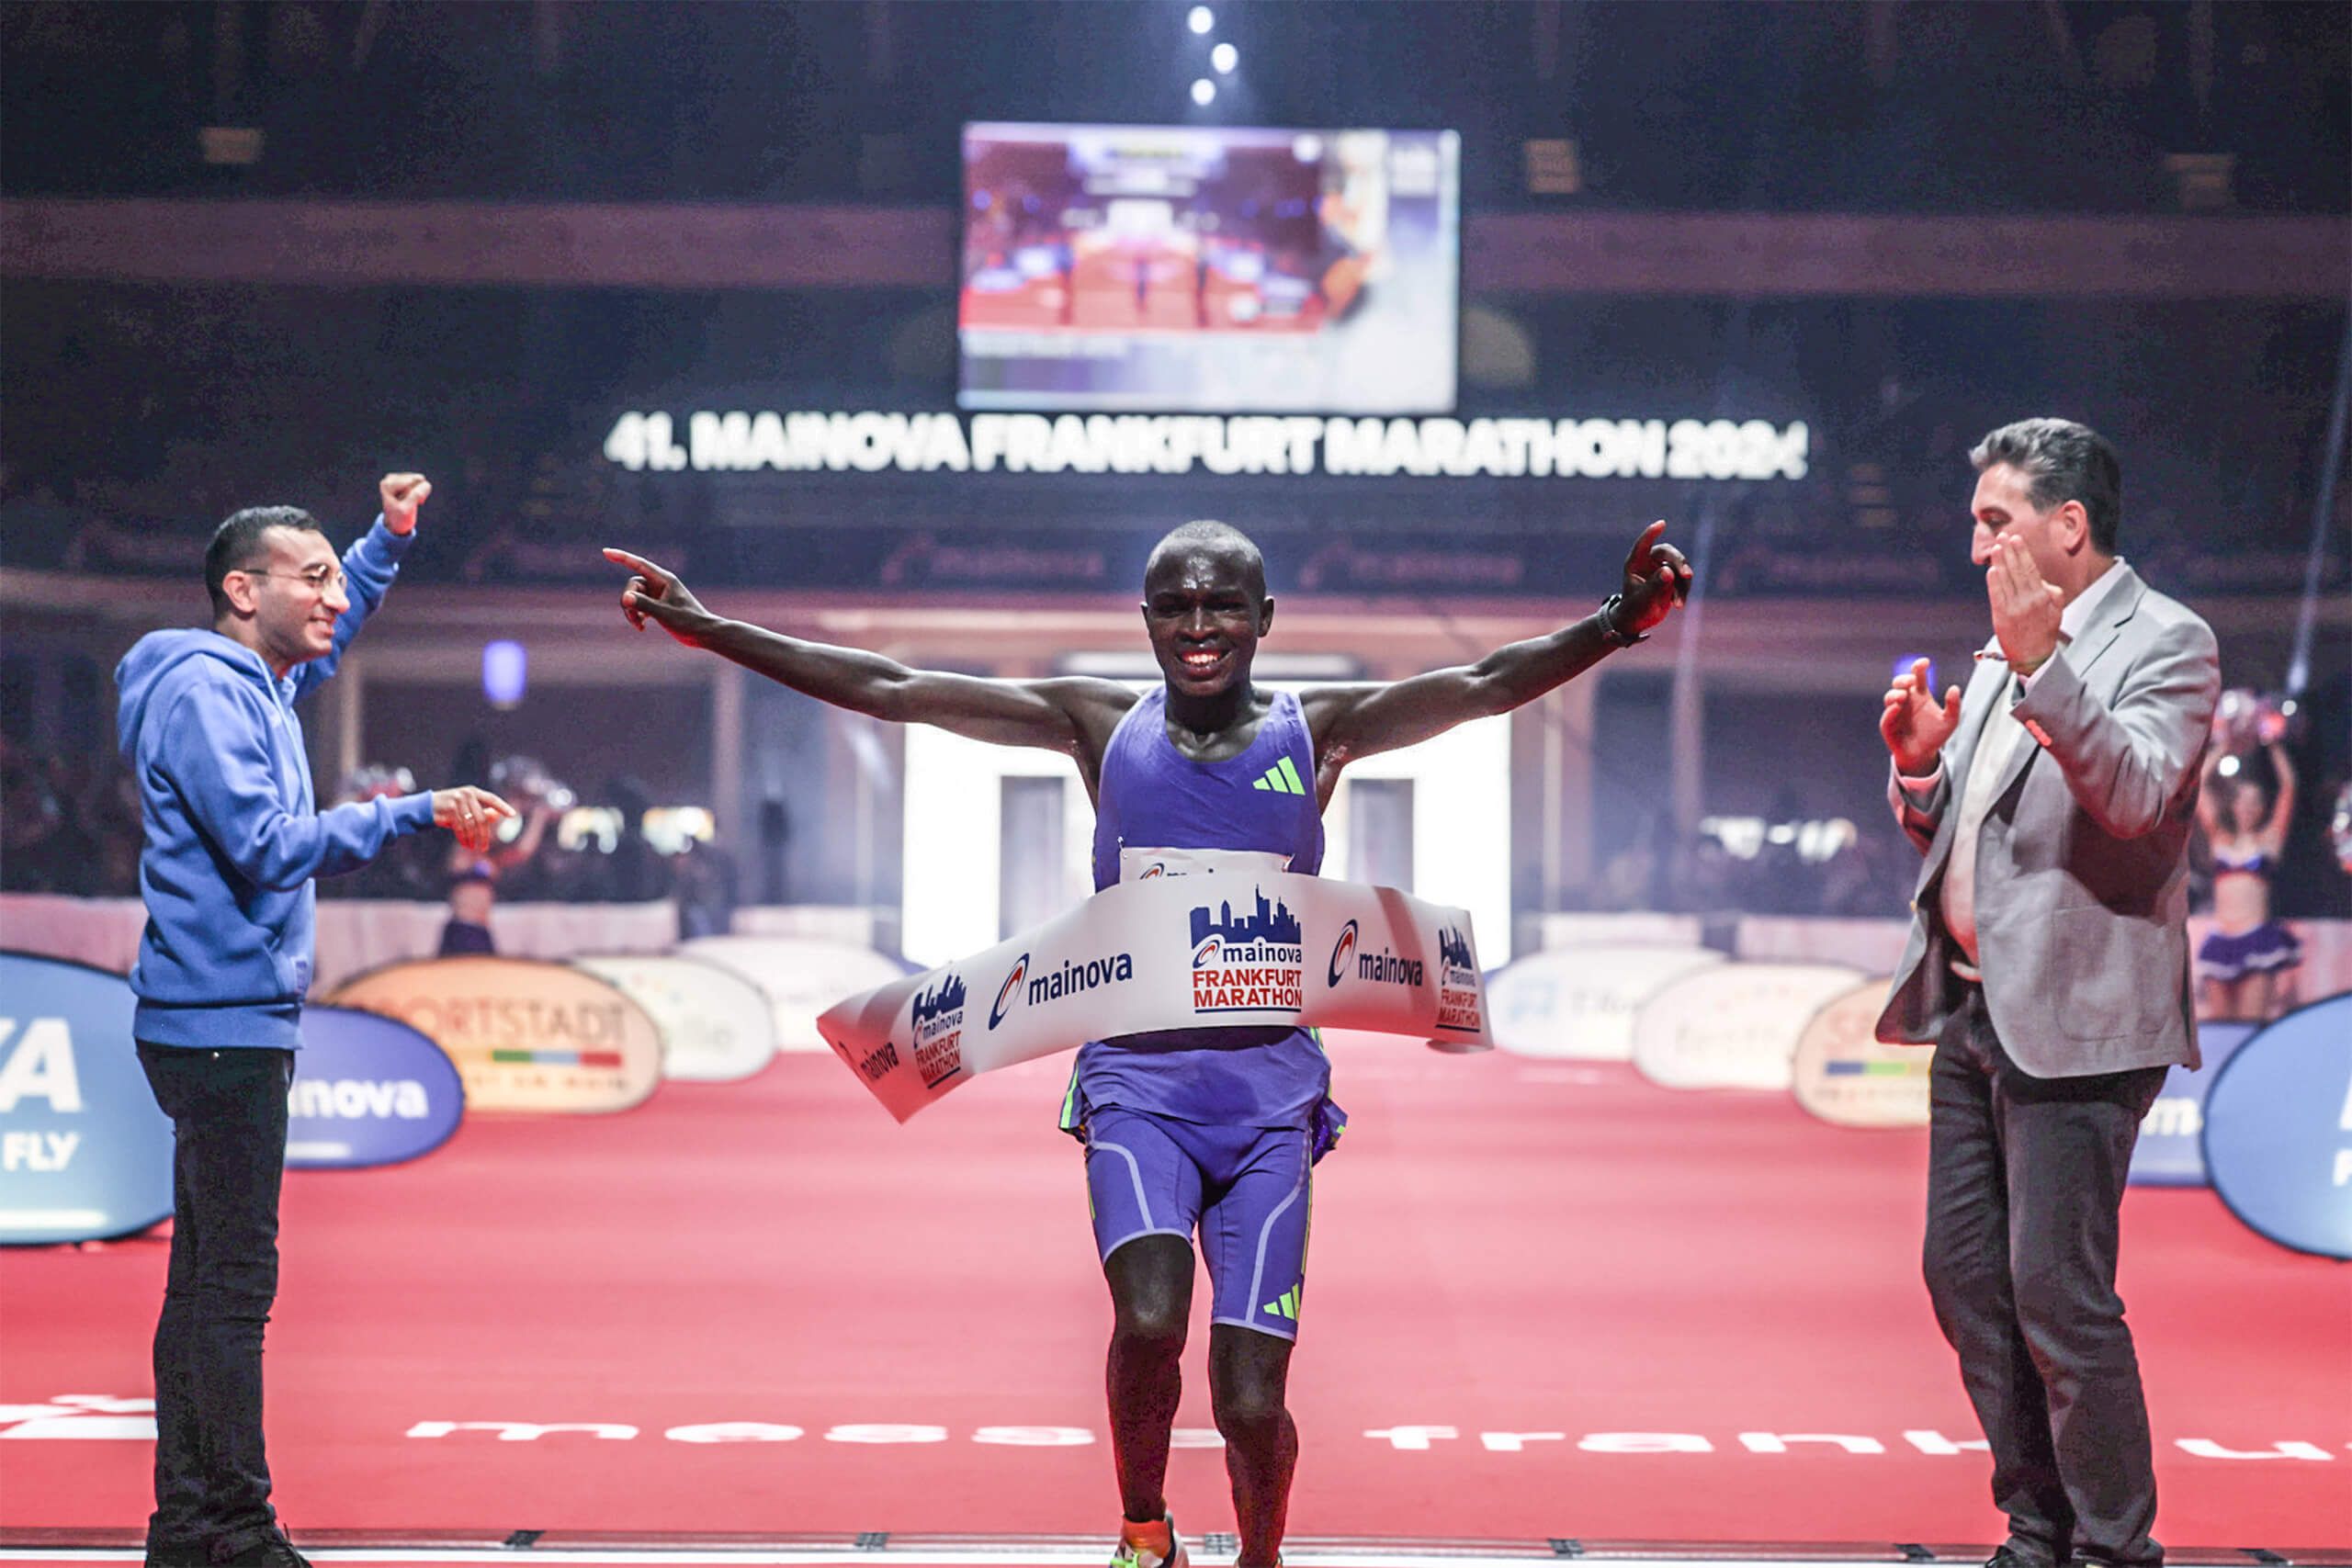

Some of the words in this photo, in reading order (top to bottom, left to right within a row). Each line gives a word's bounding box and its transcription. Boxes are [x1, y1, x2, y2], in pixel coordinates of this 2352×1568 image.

[604, 411, 687, 471] 41.
[690, 411, 971, 473] MAINOVA
[970, 414, 1323, 475] FRANKFURT
[1324, 418, 1667, 478] MARATHON
[1668, 420, 1808, 479] 2024
[1223, 943, 1302, 964] mainova
[1359, 947, 1423, 987] mainova
[1027, 953, 1133, 1006] mainova
[1193, 969, 1302, 988] FRANKFURT
[1193, 987, 1302, 1008] MARATHON
[1441, 988, 1477, 1009] FRANKFURT
[923, 1010, 963, 1040] mainova
[1439, 1006, 1480, 1029] MARATHON
[916, 1030, 961, 1066] FRANKFURT
[3, 1131, 80, 1173] FLY
